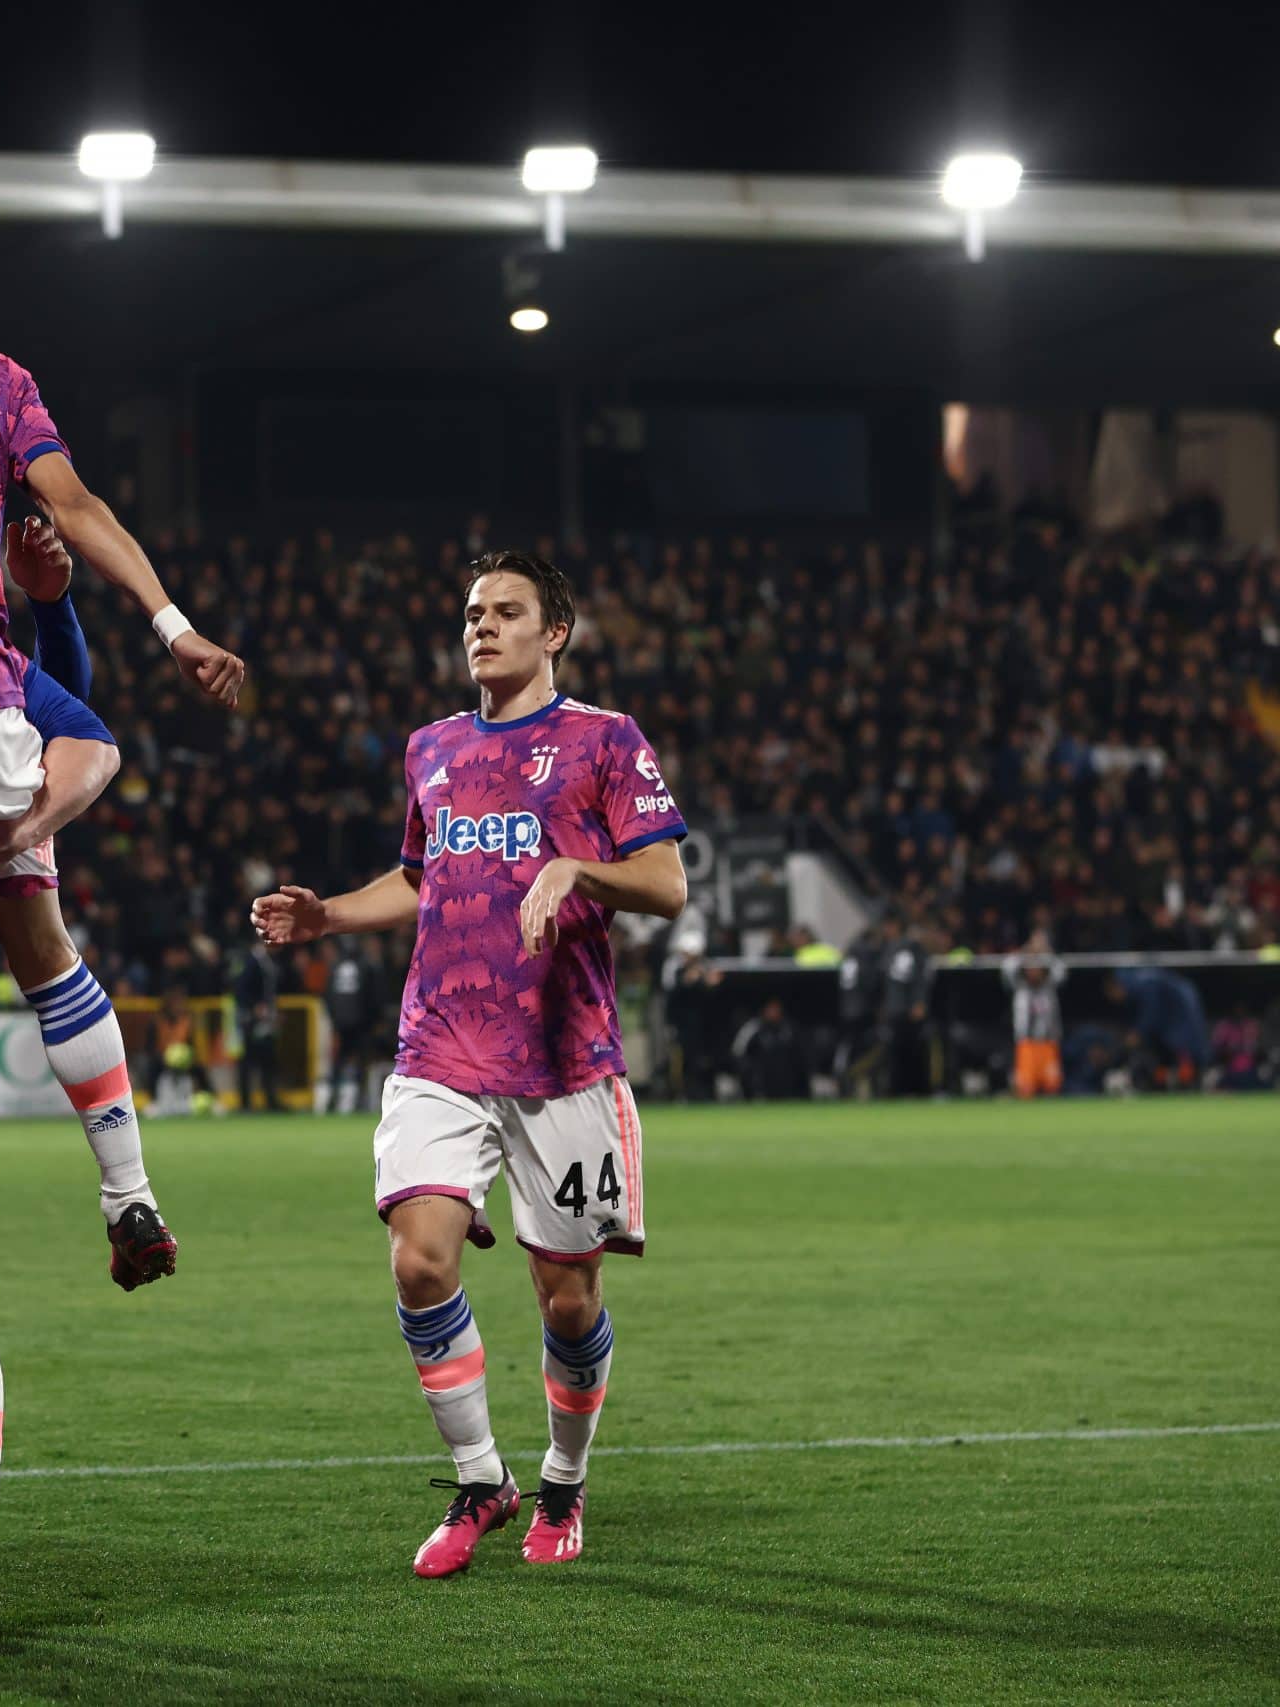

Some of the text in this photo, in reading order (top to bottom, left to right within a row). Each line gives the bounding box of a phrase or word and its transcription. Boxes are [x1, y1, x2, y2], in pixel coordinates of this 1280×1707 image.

[426, 806, 542, 862] Jeep
[89, 1112, 134, 1134] adidas
[554, 1152, 621, 1218] 44
